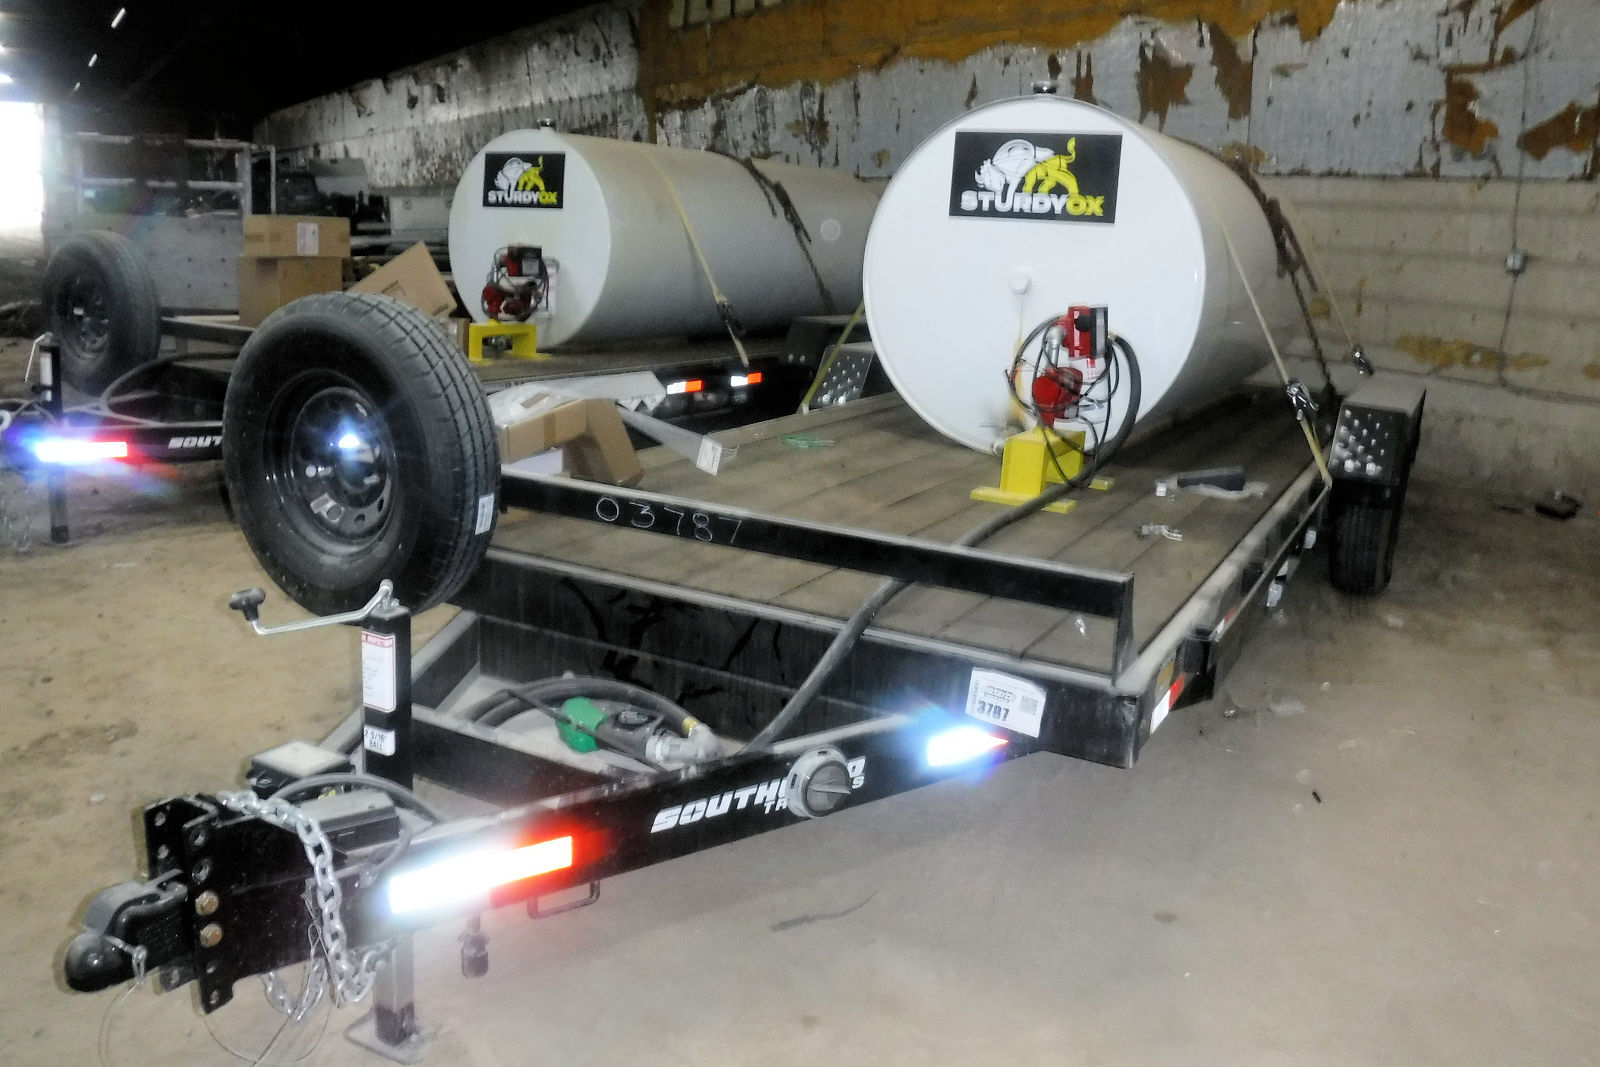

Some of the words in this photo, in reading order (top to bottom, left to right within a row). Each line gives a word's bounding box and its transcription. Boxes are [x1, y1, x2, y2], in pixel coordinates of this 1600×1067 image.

[488, 190, 558, 205] STURDYOX
[960, 189, 1104, 217] STURDYOX
[596, 497, 743, 543] 03787
[976, 699, 1010, 721] 3787
[650, 755, 867, 833] SOUTHD
